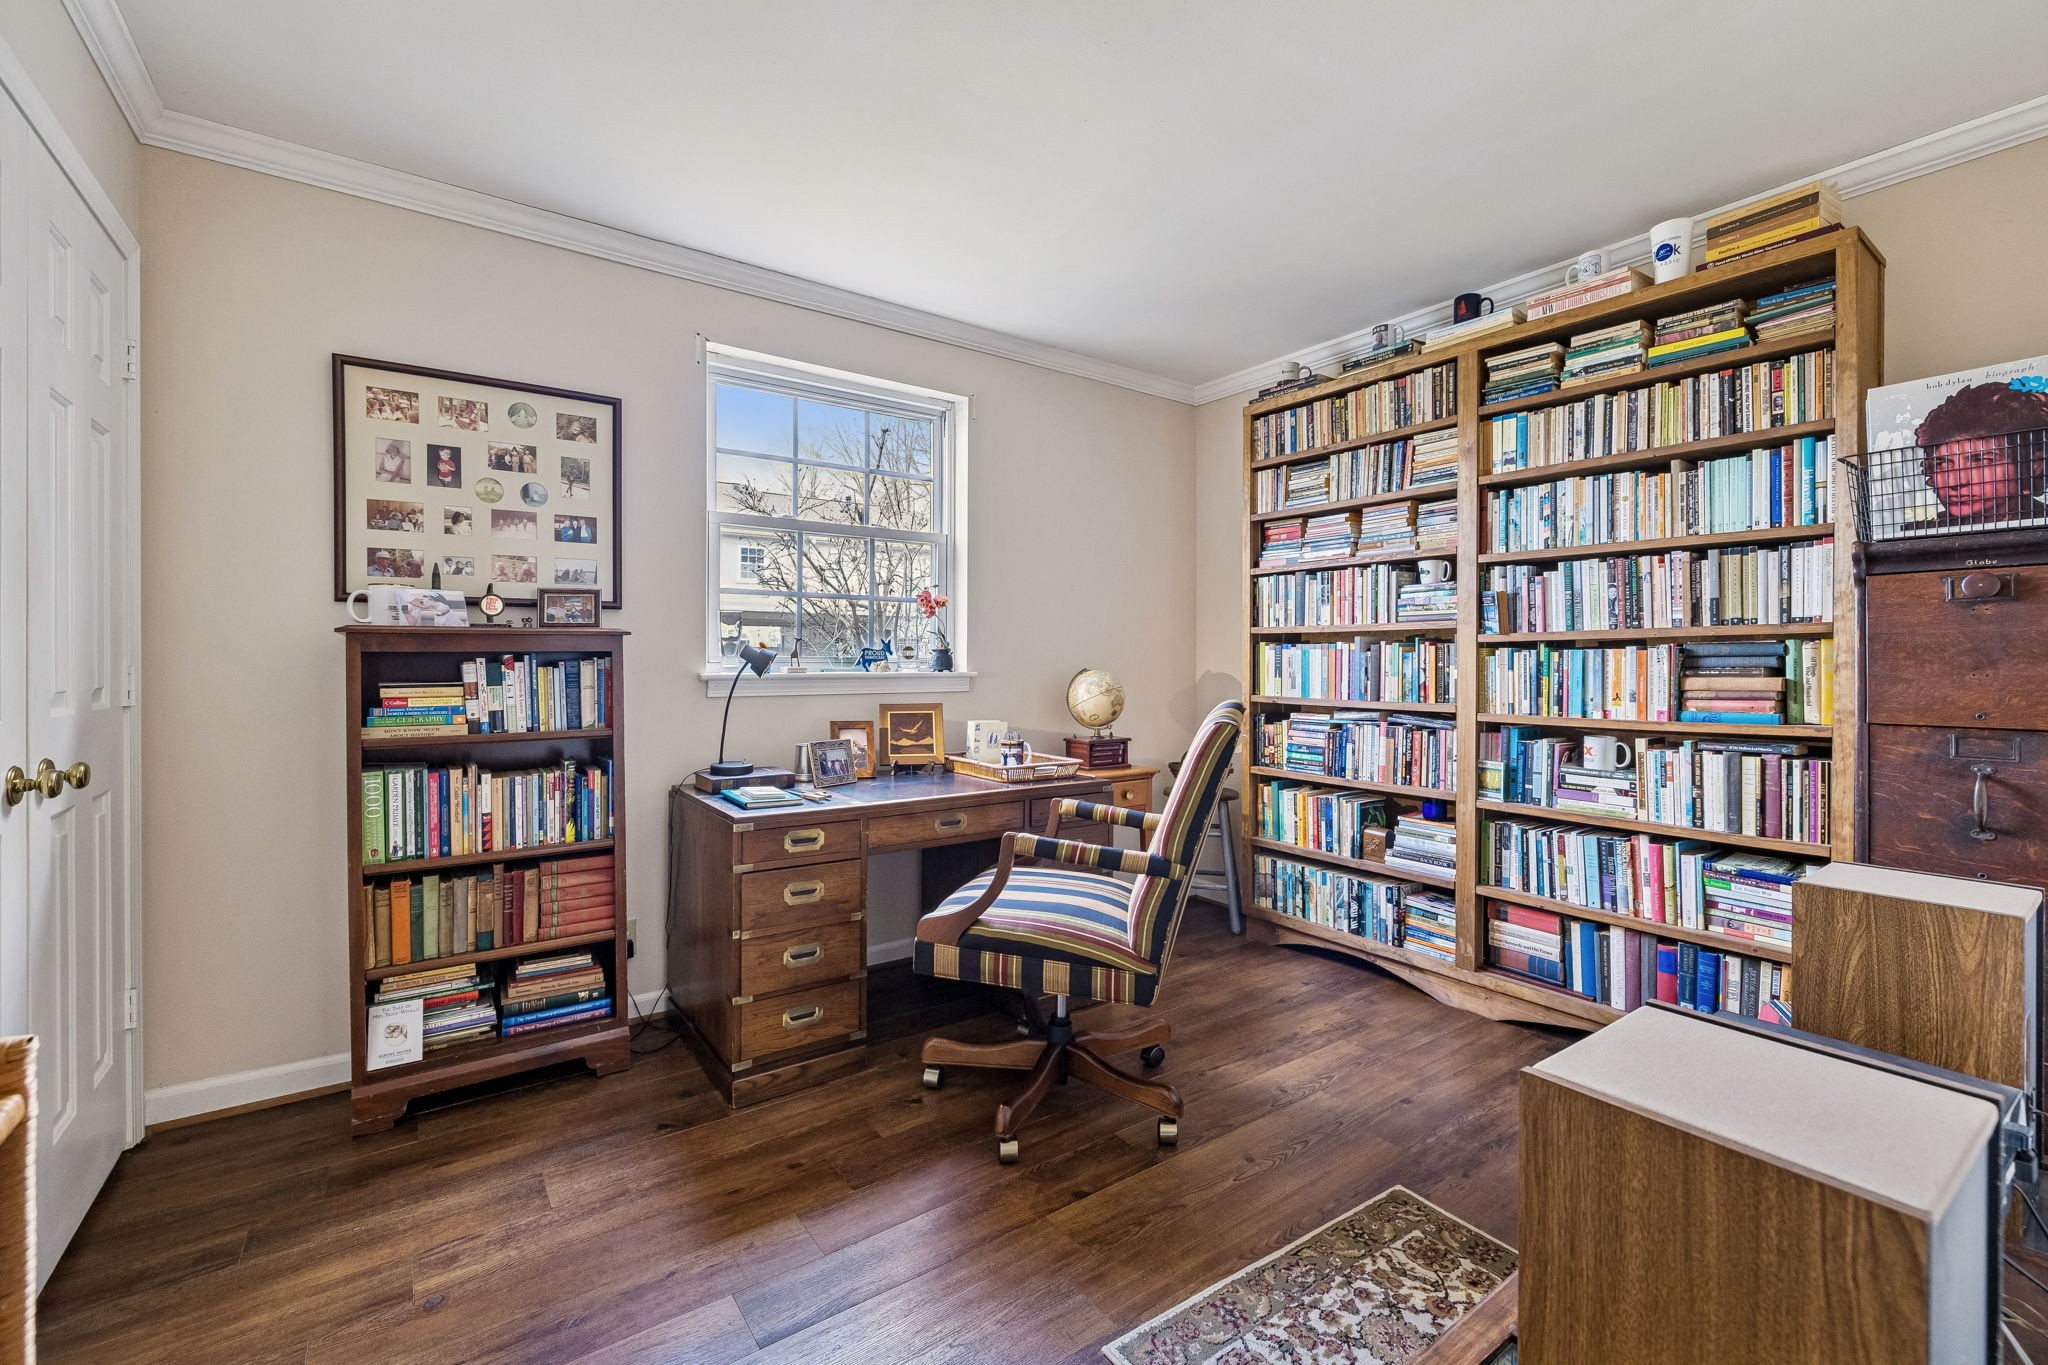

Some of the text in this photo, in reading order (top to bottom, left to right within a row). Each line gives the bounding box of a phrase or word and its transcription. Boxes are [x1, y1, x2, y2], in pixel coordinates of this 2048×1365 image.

[1542, 303, 1554, 315] NEW
[1926, 363, 2035, 390] bob dylan biograph
[1965, 558, 1998, 566] Globe
[1809, 664, 1817, 677] Things
[365, 777, 381, 818] 1000
[391, 777, 399, 805] GARDEN
[1607, 856, 1616, 873] franz
[517, 1015, 525, 1023] The
[526, 1013, 538, 1021] World
[515, 1025, 524, 1033] The
[524, 1023, 537, 1031] World
